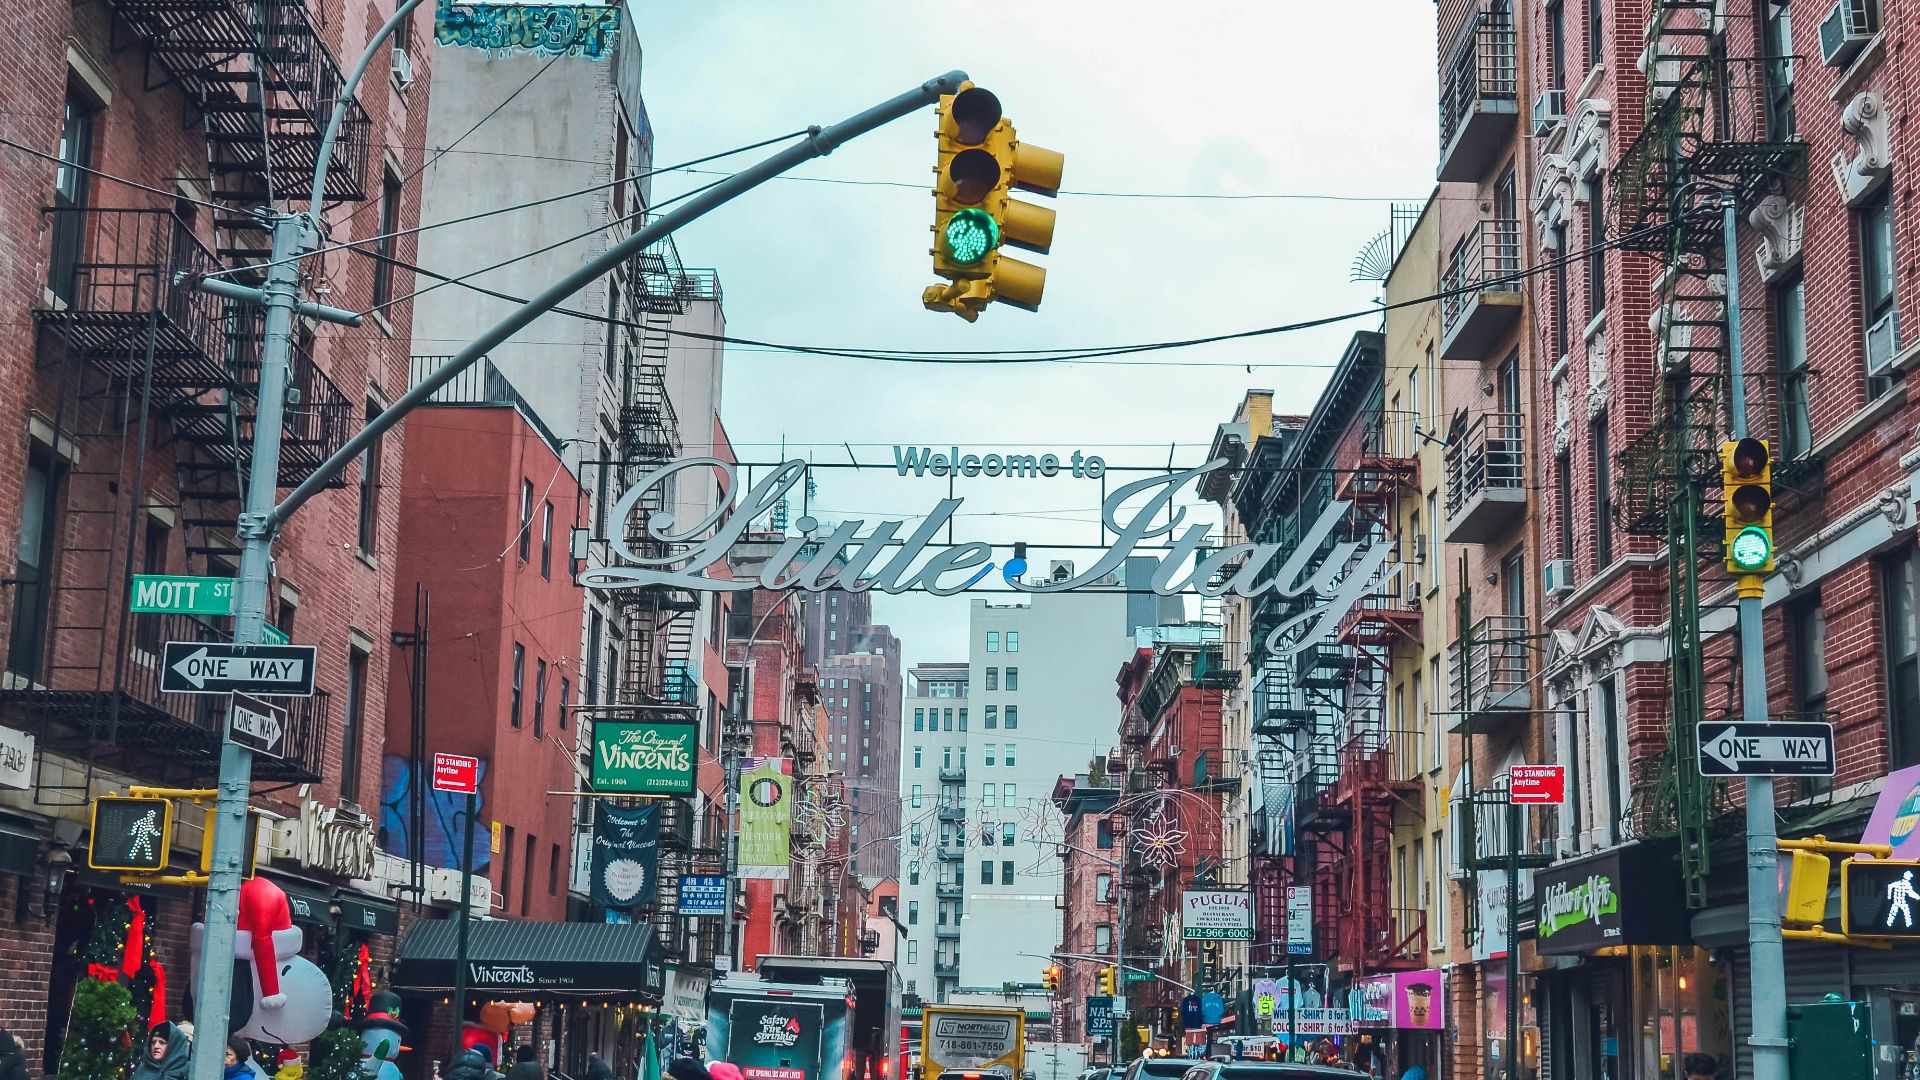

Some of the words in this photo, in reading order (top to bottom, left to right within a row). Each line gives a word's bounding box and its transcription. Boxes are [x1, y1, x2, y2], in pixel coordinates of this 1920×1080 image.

[894, 445, 1061, 478] Welcome
[1072, 447, 1107, 479] to
[579, 457, 994, 595] Little
[1003, 457, 1404, 656] Italy
[136, 580, 201, 609] MOTT
[213, 583, 231, 597] ST
[187, 658, 229, 678] ONE
[250, 660, 295, 680] WAY
[237, 709, 252, 732] ONE
[259, 717, 278, 740] WAY
[618, 729, 641, 745] The
[642, 729, 688, 752] Original
[1718, 738, 1761, 759] ONE
[1782, 739, 1821, 759] WAY
[437, 757, 445, 765] NO
[445, 758, 472, 768] STANDING
[436, 765, 459, 775] Anytime
[1513, 769, 1523, 778] NO
[1524, 769, 1556, 778] STANDING
[596, 777, 609, 785] Est.
[1513, 778, 1541, 788] Anytime
[607, 814, 638, 826] Welcome
[640, 817, 648, 826] to
[619, 827, 634, 838] The
[595, 835, 626, 849] Original
[1190, 894, 1249, 910] PUGLIA
[1297, 1009, 1325, 1020] T-SHIRT
[1328, 1010, 1333, 1020] 8
[1334, 1009, 1344, 1020] for
[759, 1014, 790, 1028] Safety
[762, 1024, 782, 1034] Fire
[956, 1023, 1006, 1032] NORTHEAST
[1297, 1022, 1325, 1033] T-SHIRT
[1328, 1022, 1333, 1033] 6
[1334, 1022, 1344, 1033] for
[753, 1031, 799, 1046] Sprinkler
[940, 1040, 1005, 1051] 718-861-7550
[790, 1071, 801, 1079] LIVES
